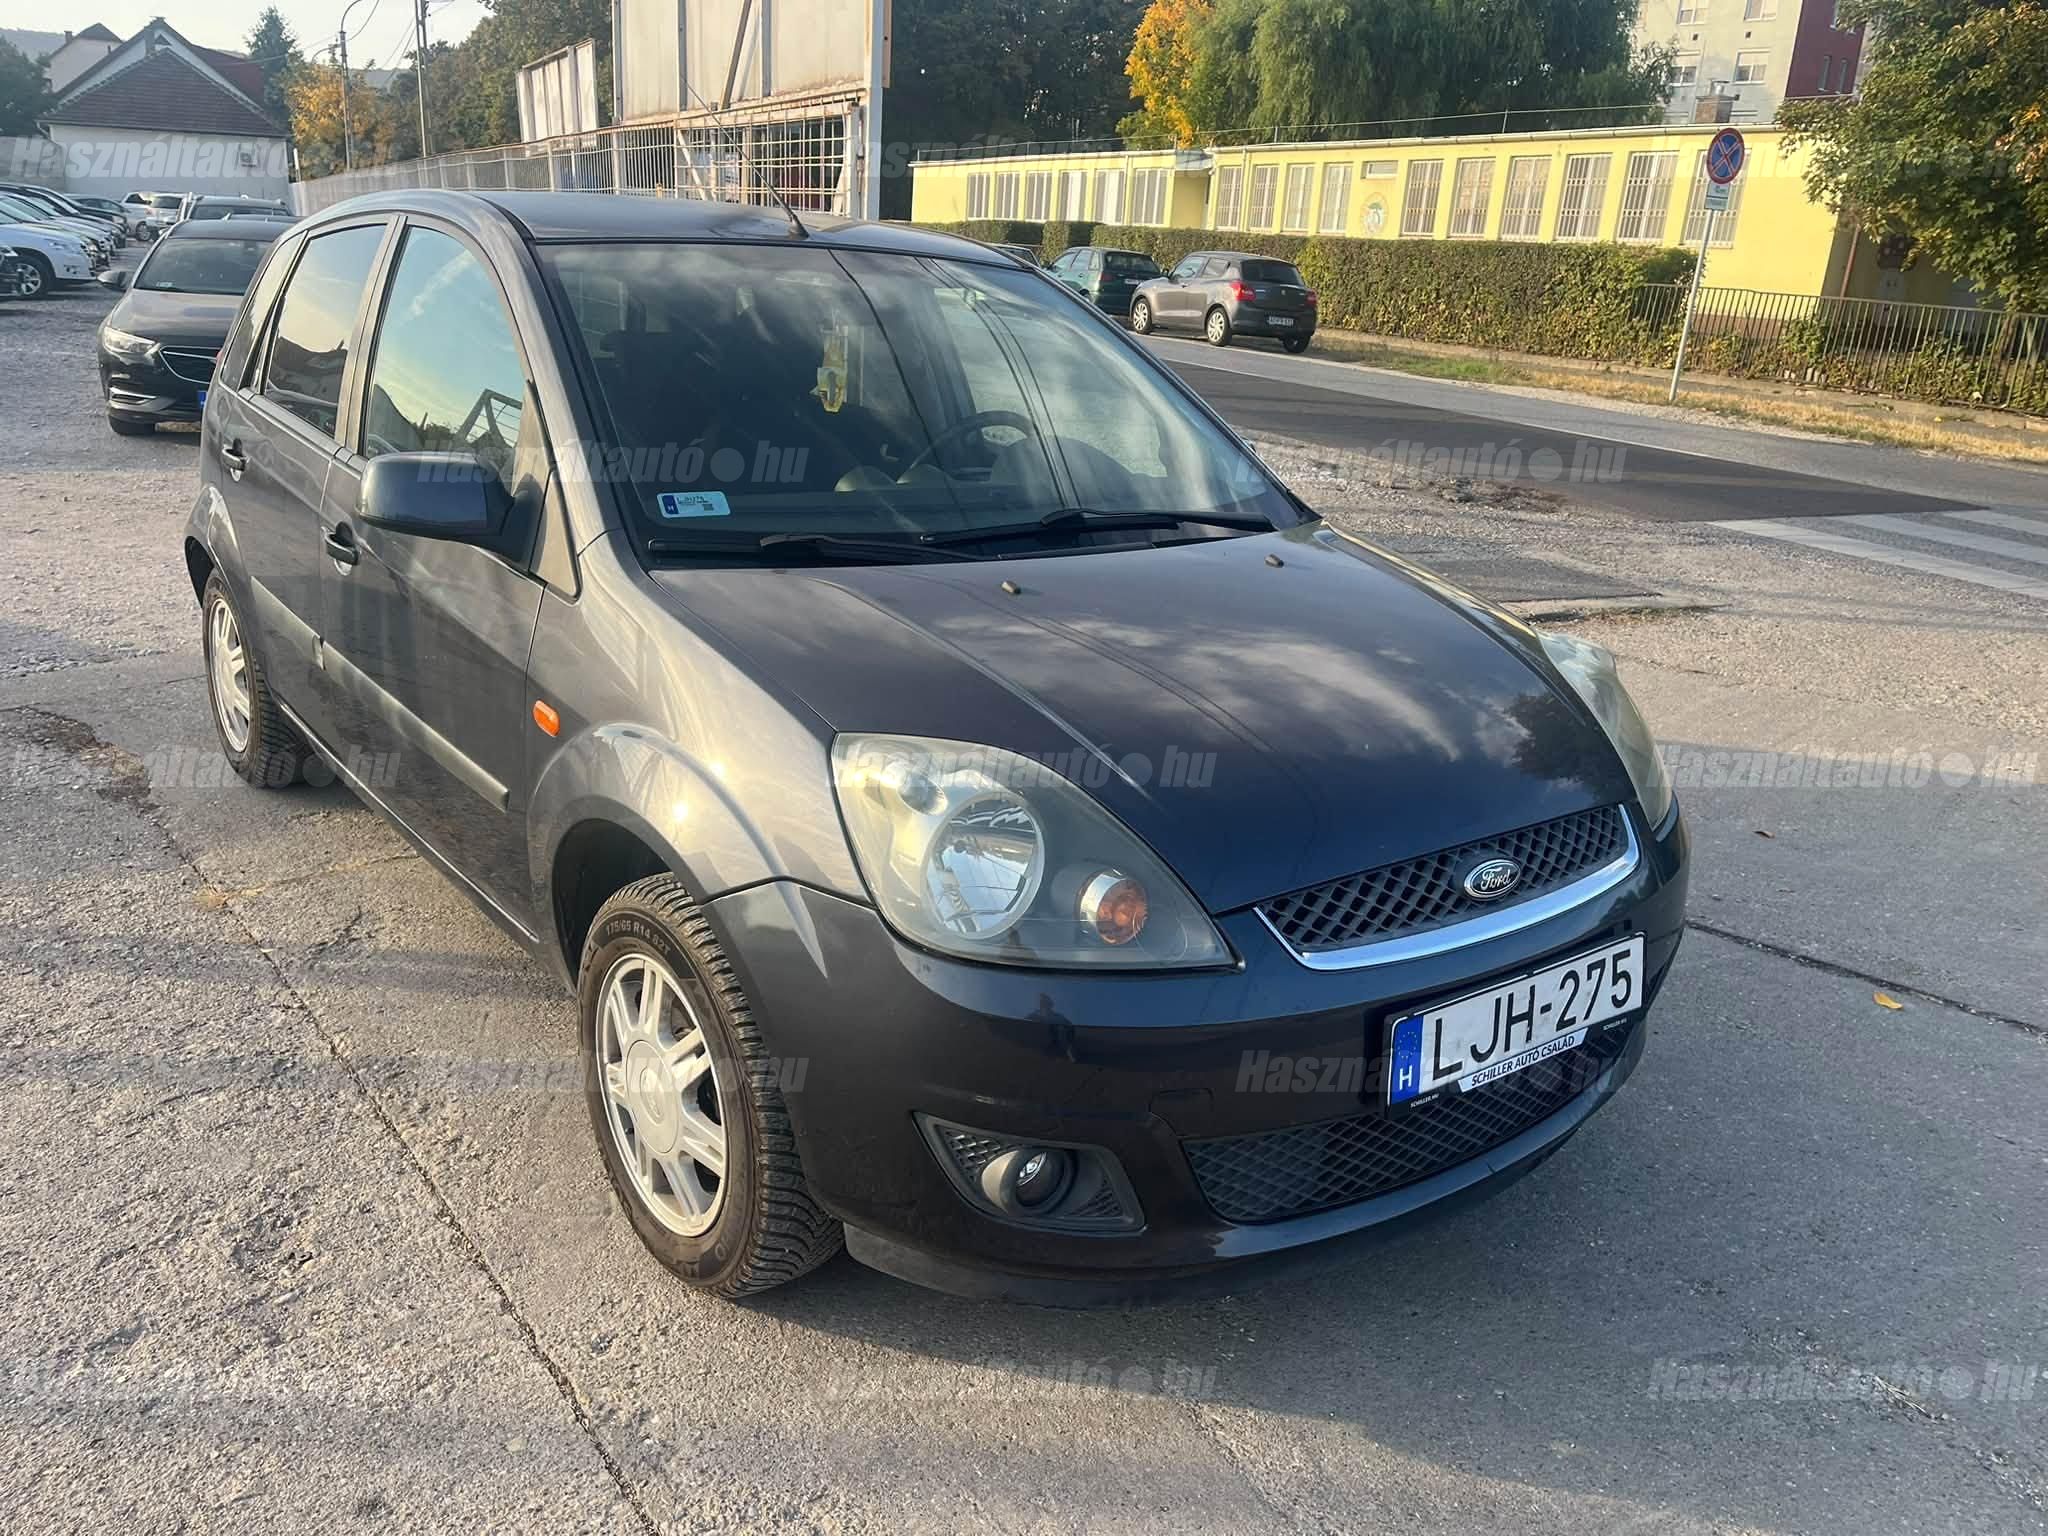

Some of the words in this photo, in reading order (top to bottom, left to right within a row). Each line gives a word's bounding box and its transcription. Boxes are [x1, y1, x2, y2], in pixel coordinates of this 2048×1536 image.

[1480, 866, 1511, 891] Ford
[1432, 948, 1633, 1082] LJH-275
[1398, 1064, 1413, 1091] H
[1471, 1060, 1513, 1087] SCHILLER
